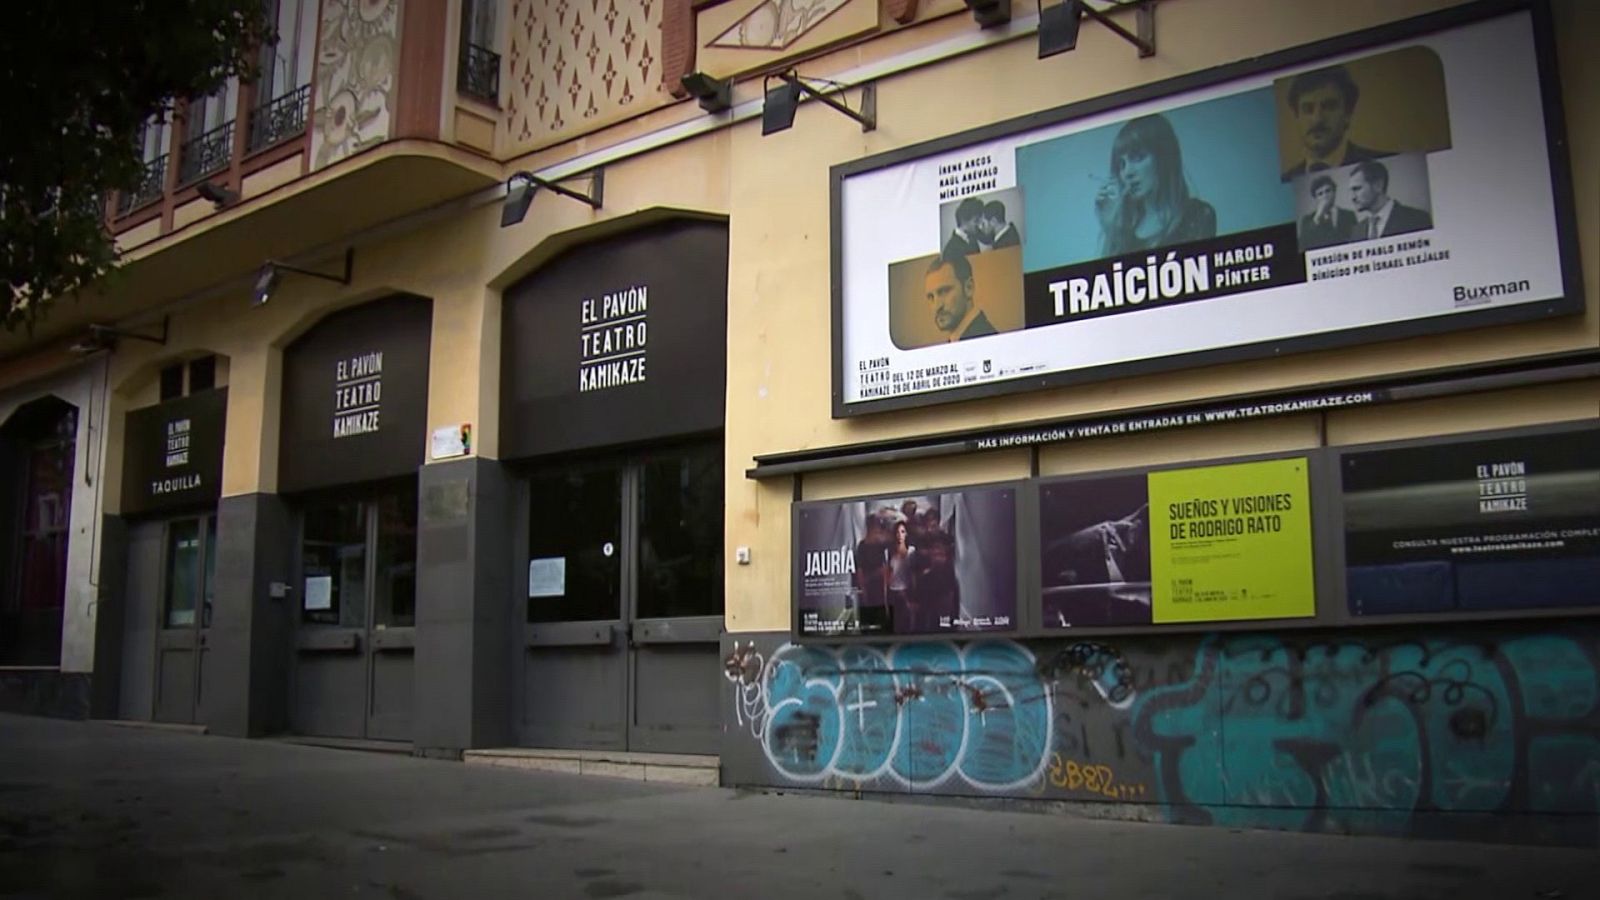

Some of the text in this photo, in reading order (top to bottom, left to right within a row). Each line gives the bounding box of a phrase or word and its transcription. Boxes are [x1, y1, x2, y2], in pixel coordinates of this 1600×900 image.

[1214, 244, 1274, 267] HAROLD
[1352, 250, 1363, 260] DE
[1353, 264, 1370, 274] POR
[1454, 280, 1530, 301] Buxman
[582, 286, 647, 324] EL PAVÓN
[581, 322, 646, 357] TEATRO
[337, 360, 348, 381] EL
[580, 357, 646, 392] KAMIKAZE
[860, 360, 867, 371] EL
[893, 363, 959, 383] DEL 12 DE MARZO AL
[860, 371, 890, 384] TEATRO
[903, 382, 910, 392] DE
[933, 377, 941, 387] DE
[336, 381, 381, 409] TEATRO
[333, 410, 380, 439] KAMIKAZE
[978, 392, 1373, 449] MÁS INFORMACIÓN Y VENTA DE ENTRADAS EN WWW.TEATROKAMIKAZE.COM
[1476, 464, 1489, 479] EL
[152, 473, 201, 495] TAQUILLA
[1479, 480, 1527, 496] TEATRO
[1169, 493, 1292, 520] SUEÑOS Y VISIONES
[1479, 498, 1528, 514] KAMIKAZE
[1170, 515, 1281, 540] DE RODRIGO RATO
[804, 545, 856, 577] JAURÍA
